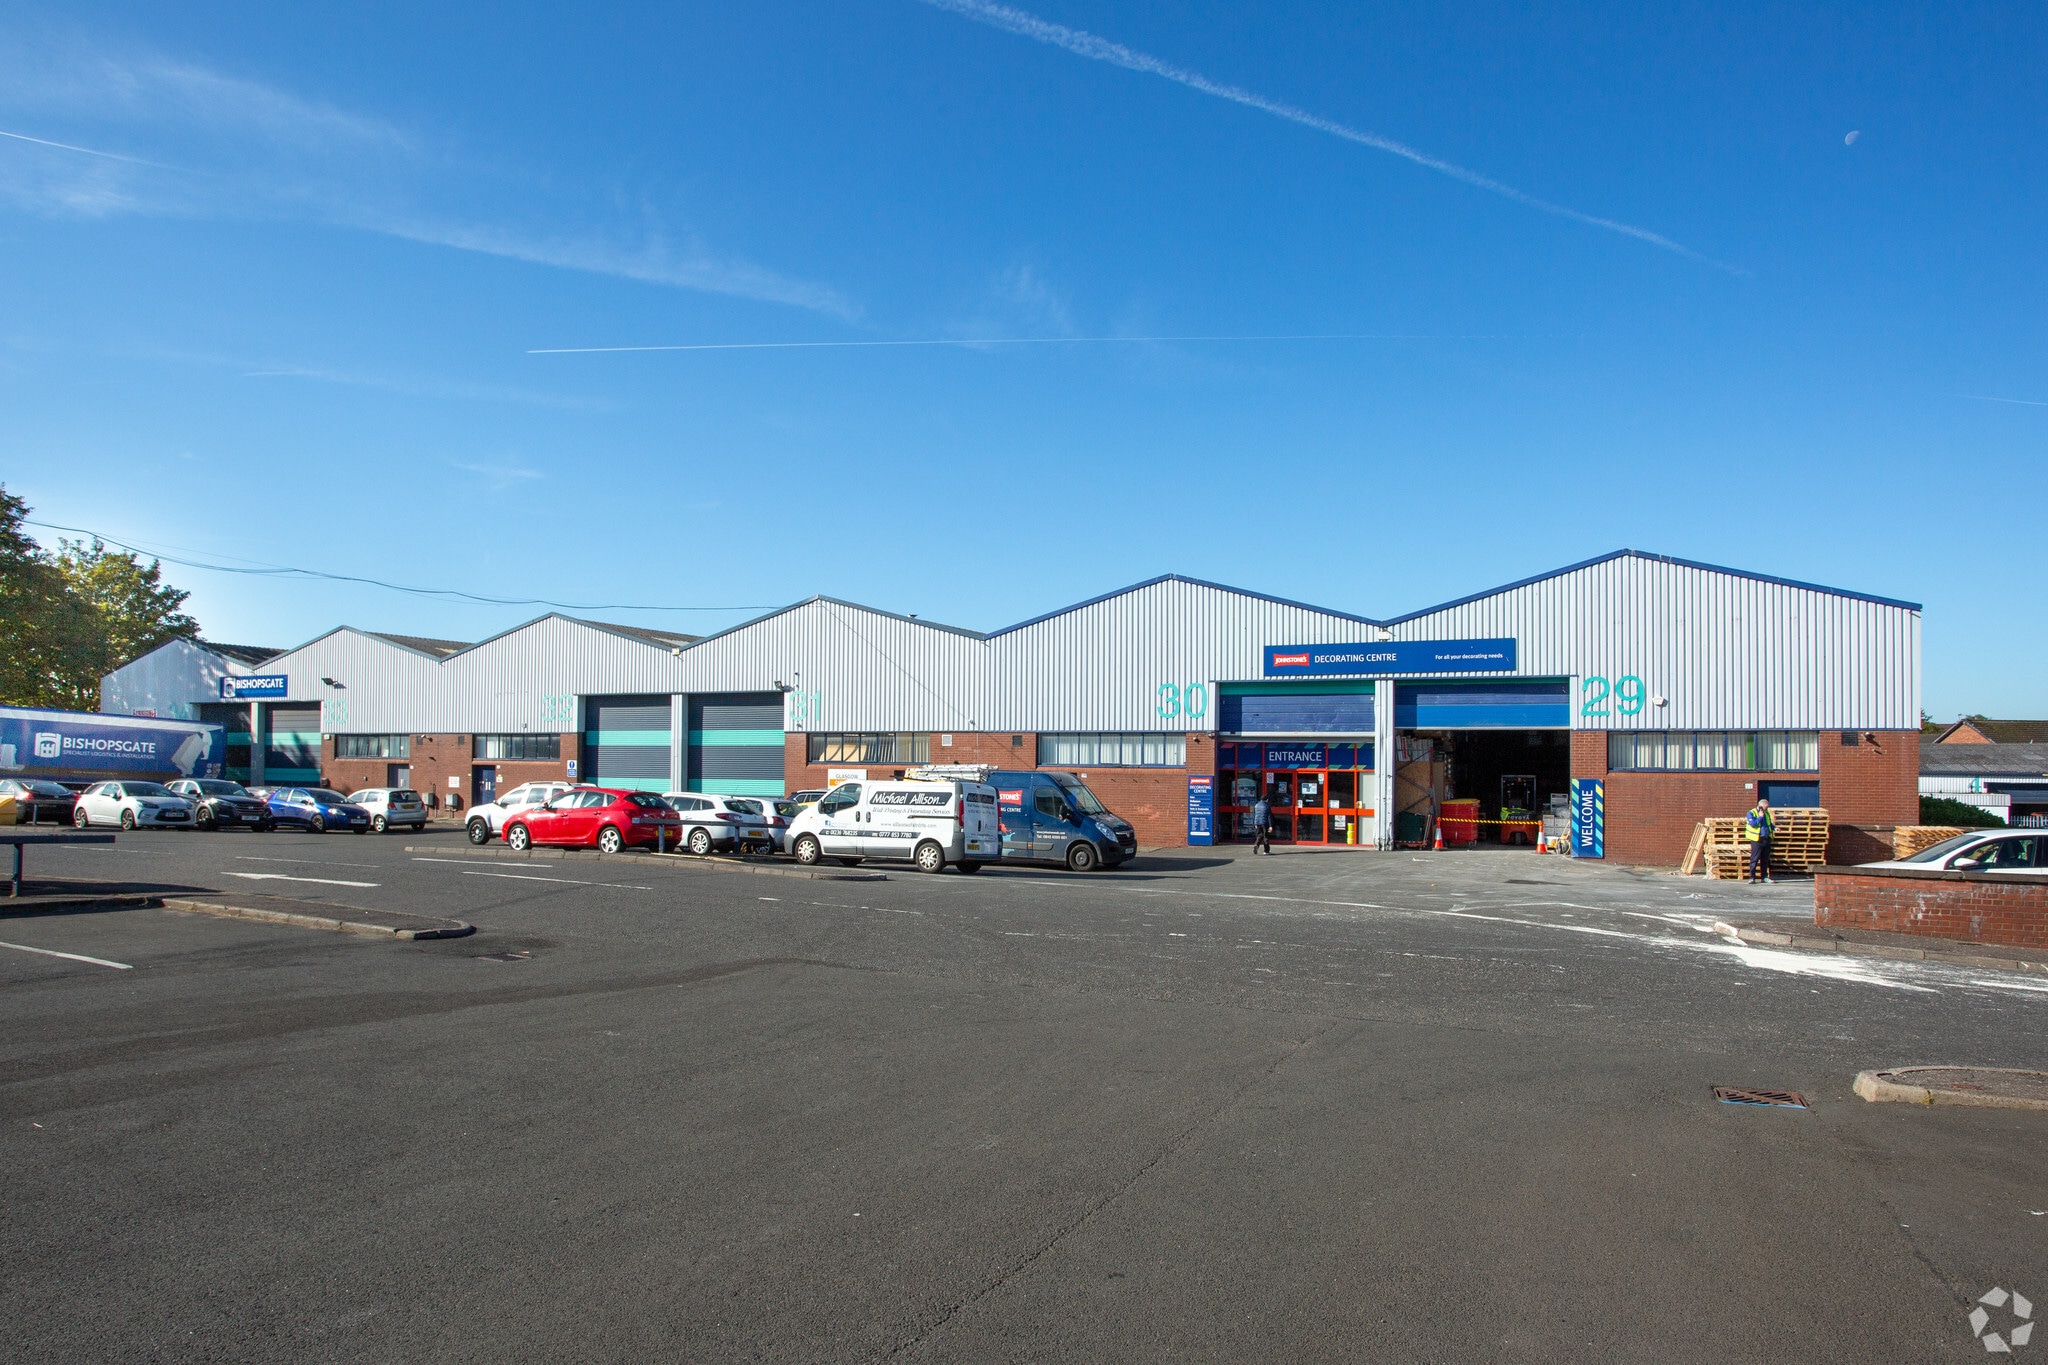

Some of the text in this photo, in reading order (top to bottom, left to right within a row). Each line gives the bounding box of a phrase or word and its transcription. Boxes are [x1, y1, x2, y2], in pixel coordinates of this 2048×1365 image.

[1314, 654, 1364, 663] DECORATING
[1366, 653, 1397, 662] CENTRE
[236, 677, 284, 689] BISHOPSGATE
[790, 690, 821, 722] 31
[1157, 682, 1208, 719] 30
[1581, 675, 1645, 717] 29
[323, 698, 348, 724] 33
[541, 693, 573, 722] 32
[63, 737, 156, 753] BISHOPSGATE
[1268, 751, 1322, 762] ENTRANCE
[1968, 776, 1982, 793] 4
[872, 792, 940, 804] Michael Allison
[1581, 789, 1594, 847] WELCOME
